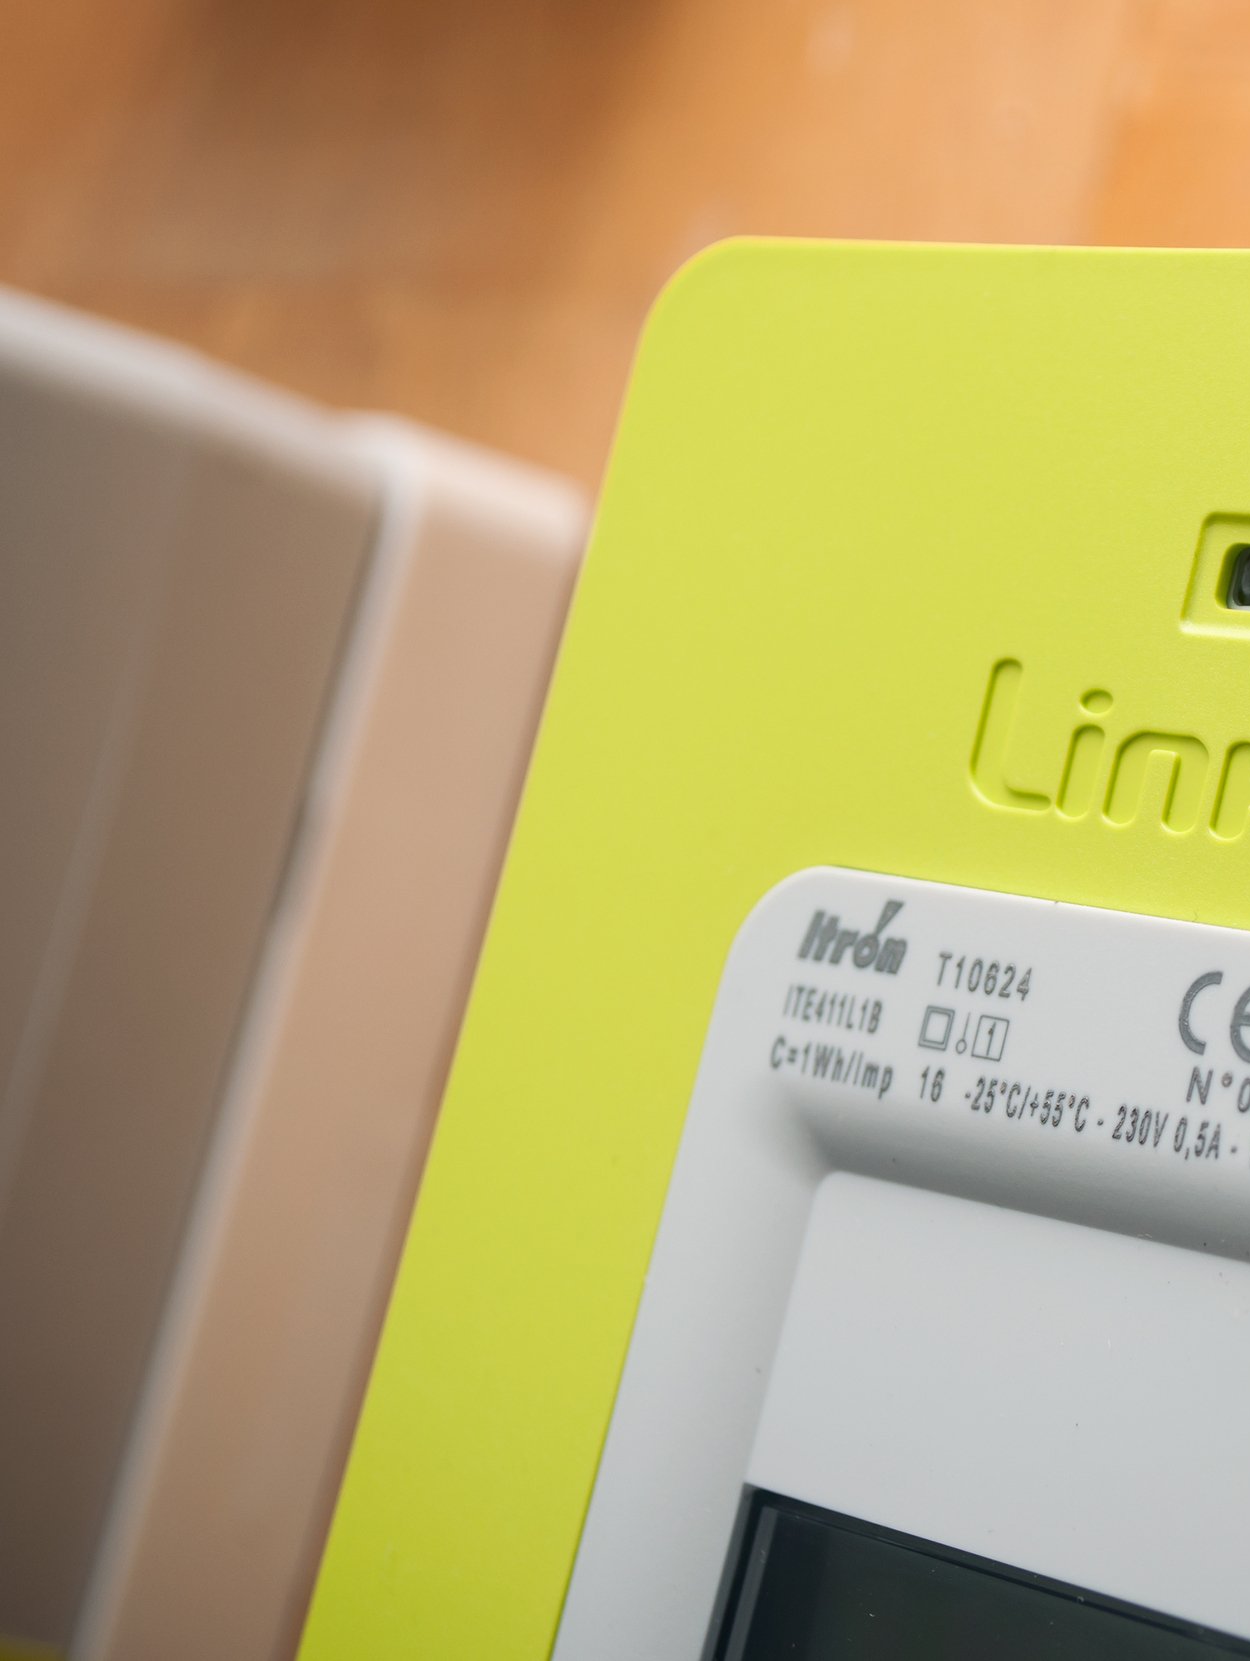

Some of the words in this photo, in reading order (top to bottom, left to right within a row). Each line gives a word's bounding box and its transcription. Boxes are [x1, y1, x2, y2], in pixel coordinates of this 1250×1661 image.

[797, 899, 907, 976] Itron
[936, 951, 1033, 1001] T10624
[782, 984, 883, 1035] ITE411L1B
[919, 1064, 946, 1103] 16
[1111, 1103, 1170, 1149] 230V
[1173, 1115, 1223, 1160] 0,5A
